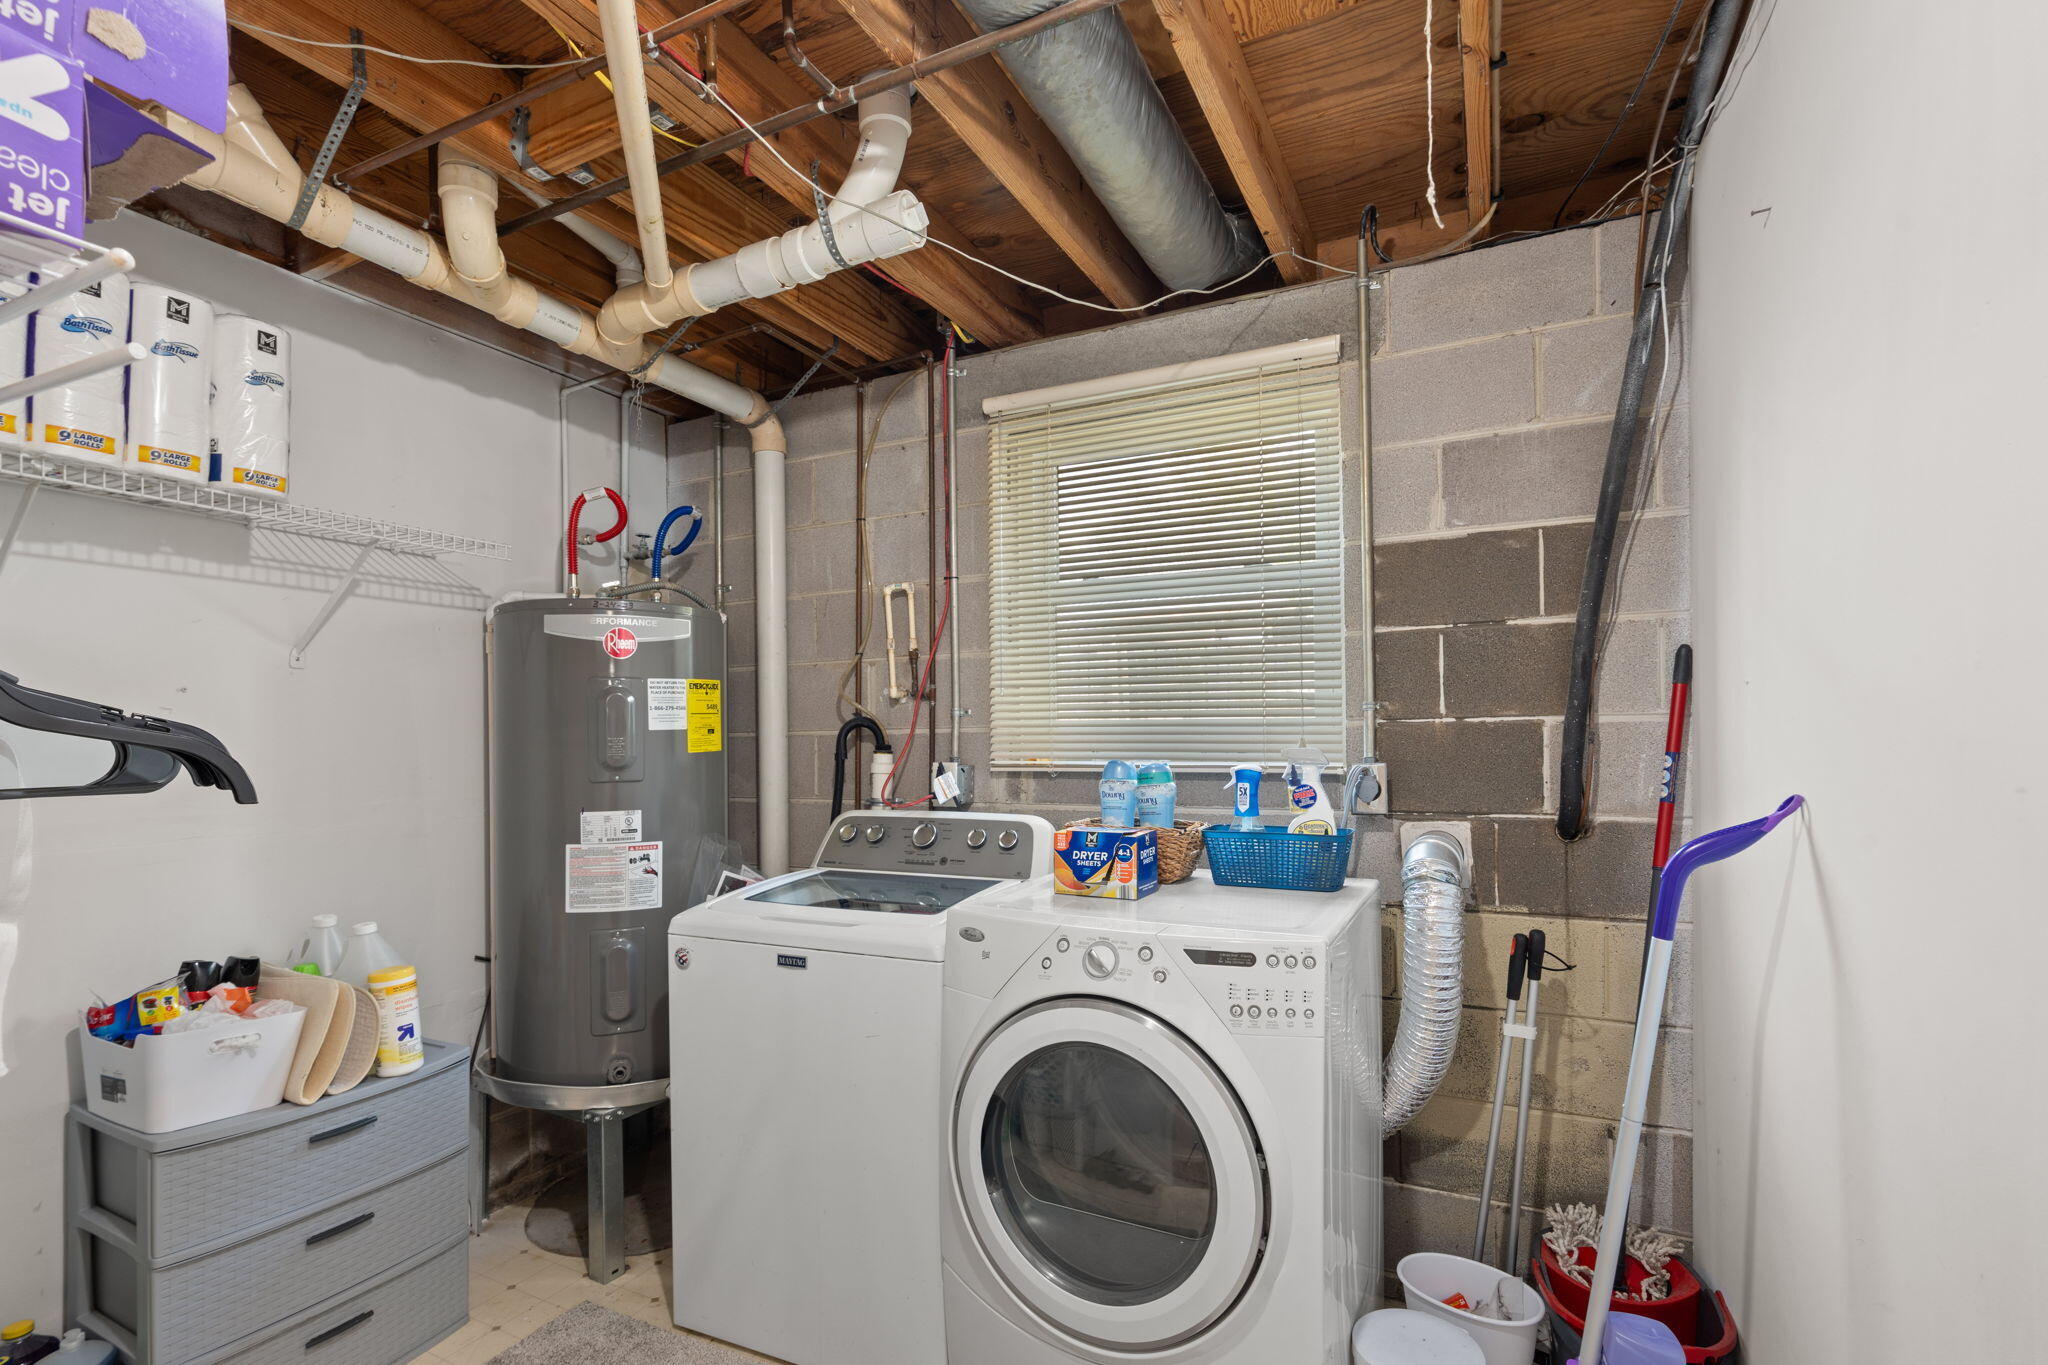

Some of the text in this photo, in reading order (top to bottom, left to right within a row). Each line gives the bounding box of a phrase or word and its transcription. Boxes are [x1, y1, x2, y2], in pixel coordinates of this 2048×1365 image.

[8, 182, 71, 231] jet
[59, 430, 71, 442] 9
[73, 431, 105, 444] LARGE
[150, 450, 161, 460] 9
[163, 451, 191, 463] LARGE
[244, 471, 254, 482] 9
[255, 473, 279, 483] LARGE
[589, 616, 658, 627] ERFORMANCE
[607, 627, 636, 654] Rheem
[1101, 790, 1125, 800] Downy
[1137, 797, 1158, 806] owny
[1072, 850, 1108, 861] DRYER
[1140, 847, 1156, 860] DRYER
[778, 956, 806, 968] MAYTAG
